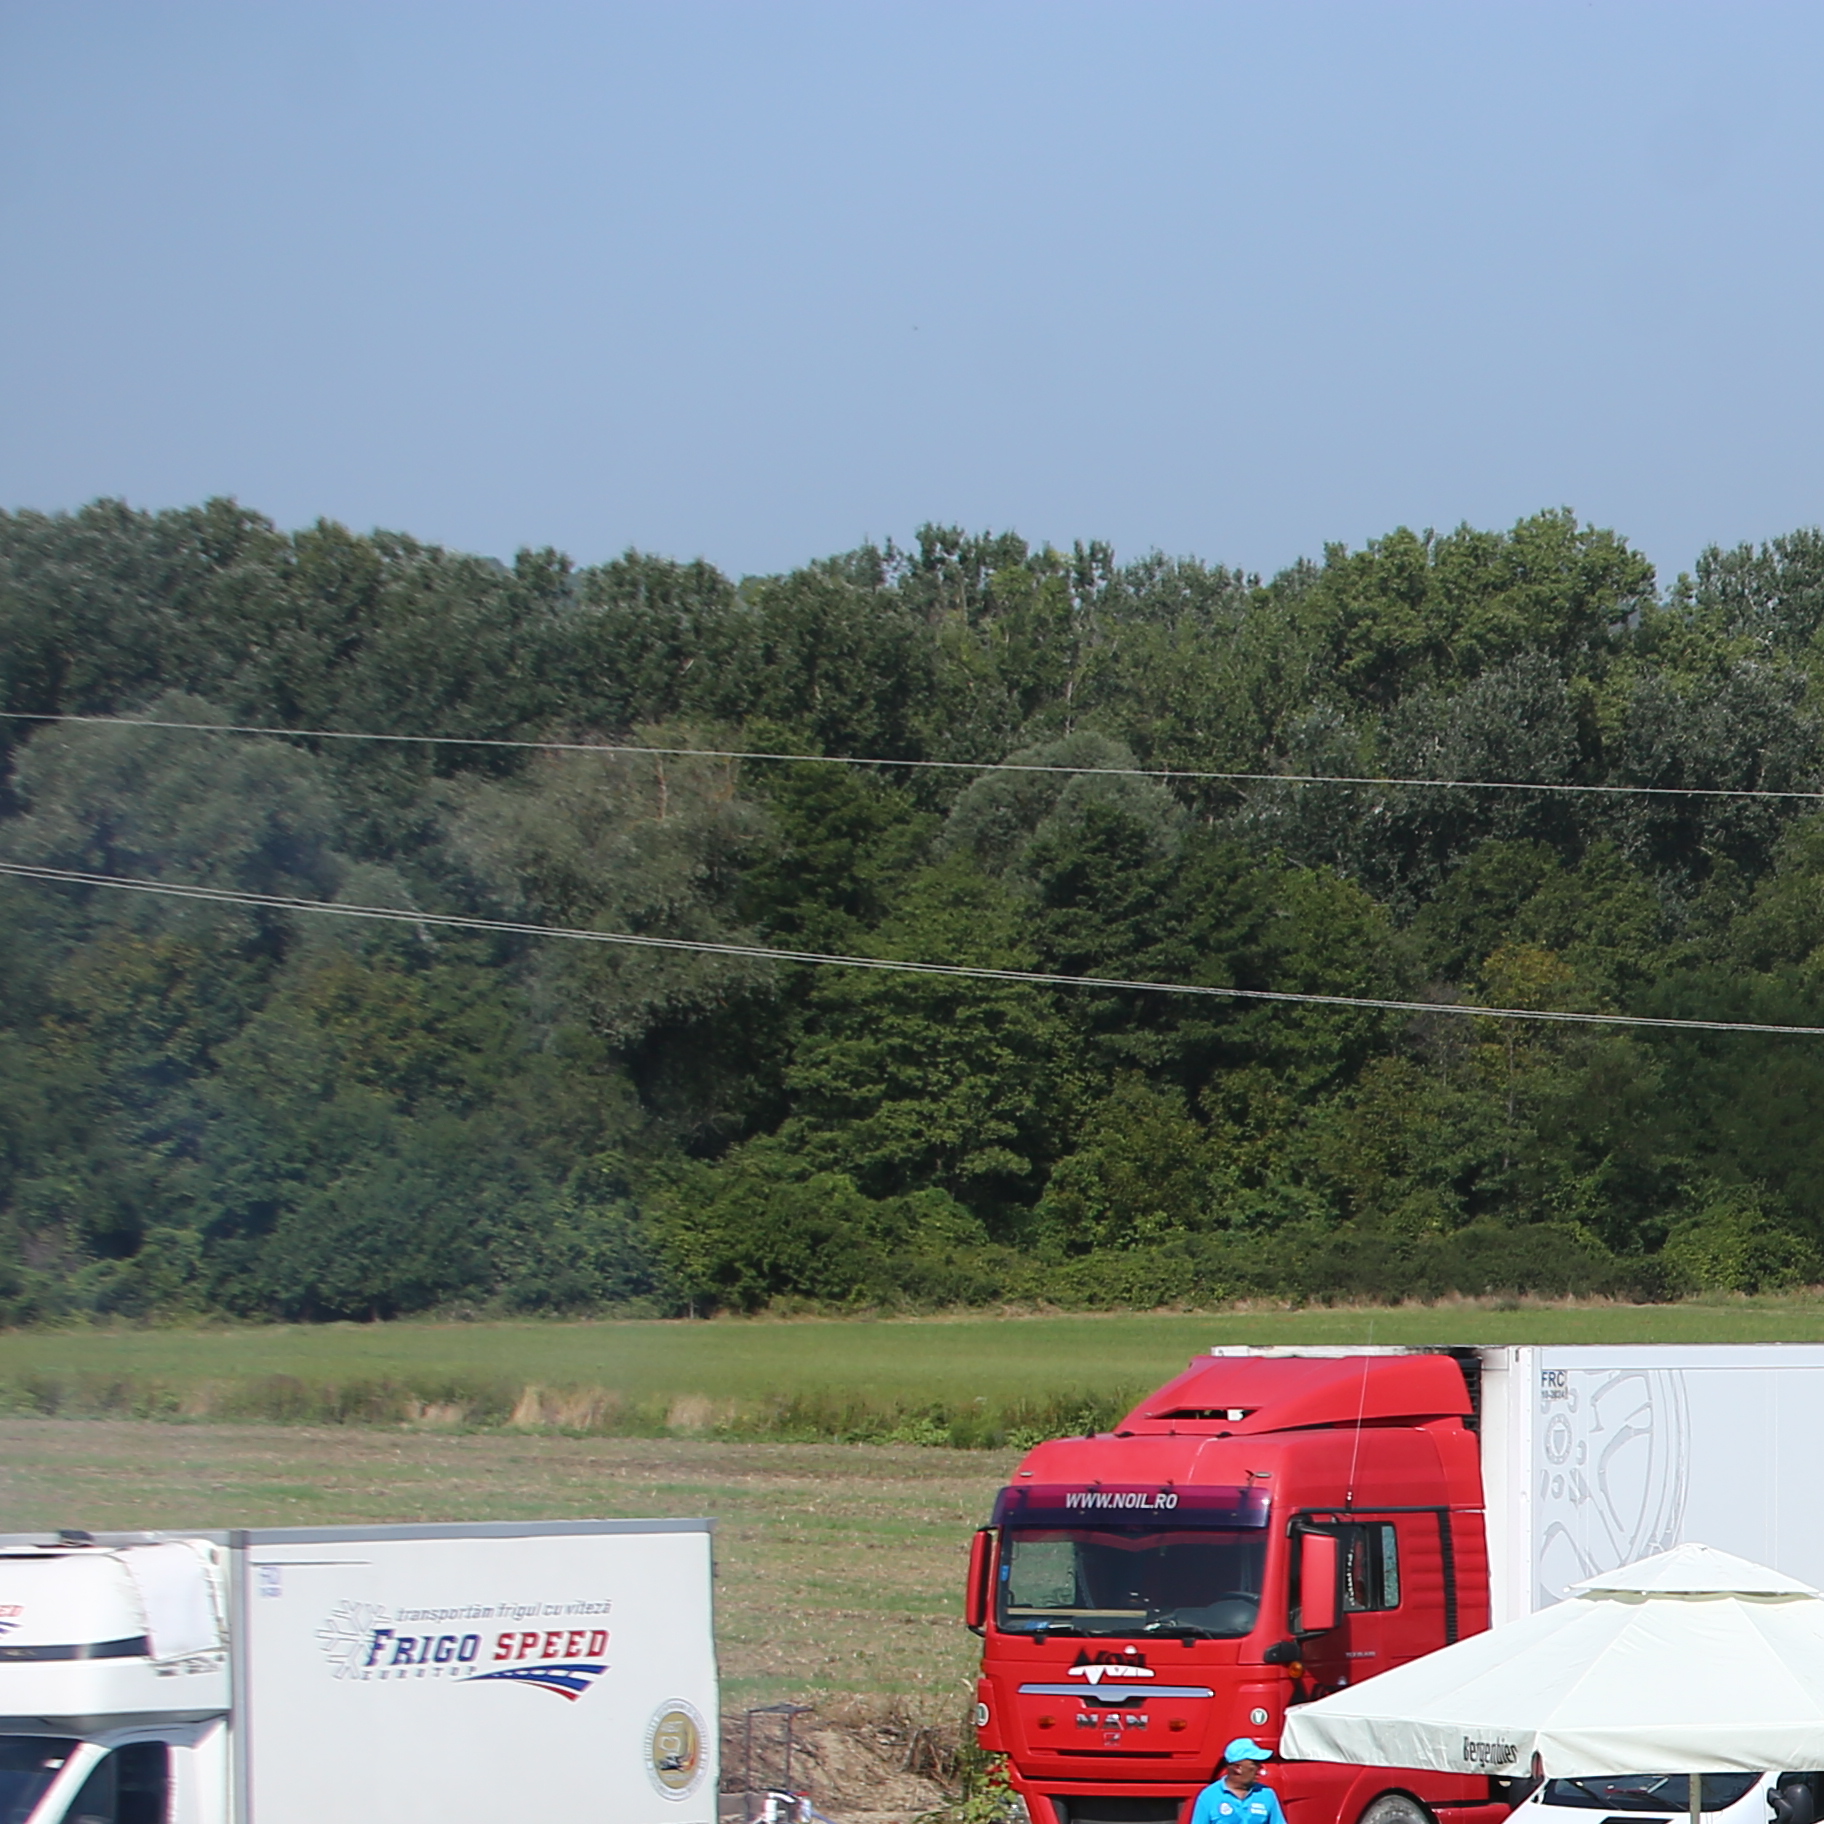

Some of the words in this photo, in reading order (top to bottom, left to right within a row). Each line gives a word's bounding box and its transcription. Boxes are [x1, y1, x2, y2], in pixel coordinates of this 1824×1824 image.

[1541, 1371, 1565, 1387] FRC
[1065, 1492, 1179, 1510] WWW.NOIL.RO
[497, 1602, 542, 1622] frigul
[542, 1604, 563, 1616] cu
[363, 1628, 482, 1667] FRIGO
[492, 1629, 611, 1661] SPEED
[1076, 1714, 1149, 1730] MAN
